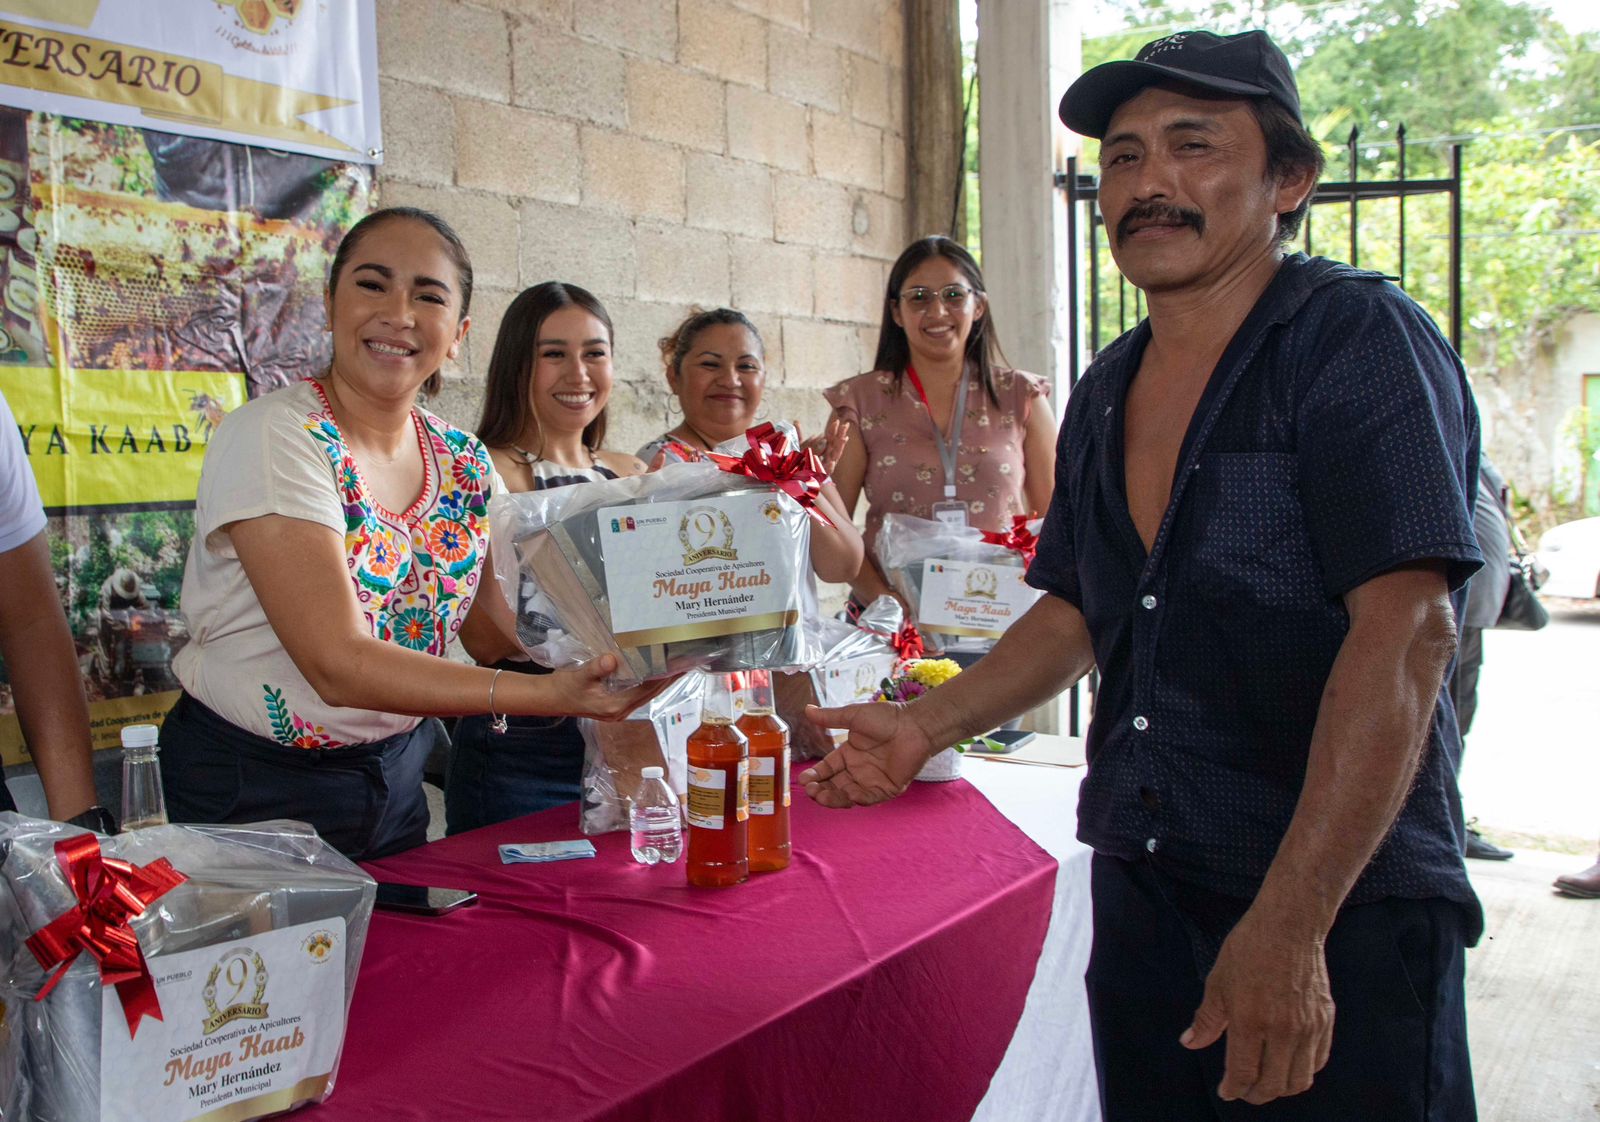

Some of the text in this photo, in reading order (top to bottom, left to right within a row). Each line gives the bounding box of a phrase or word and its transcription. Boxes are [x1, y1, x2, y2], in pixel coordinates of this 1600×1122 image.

[0, 28, 201, 97] ERSARIO
[89, 424, 192, 455] KAAB
[694, 513, 716, 547] 9
[655, 570, 685, 578] Sociedad
[686, 566, 722, 576] Cooperativa
[732, 560, 765, 571] Apicultores
[688, 548, 733, 562] ANIVERSARIO
[653, 568, 772, 600] Maya Kaab
[675, 593, 755, 612] Mary Hernández
[687, 606, 748, 619] Presidenta Municipal
[167, 970, 193, 981] PUEBLO
[225, 957, 248, 1006] 9
[208, 1006, 262, 1029] ANIVERSARIO
[170, 1015, 301, 1058] Sociedad Cooperativa de Apicultores
[163, 1026, 305, 1087] Maya Kaab
[188, 1061, 282, 1099] Mary Hernández
[200, 1079, 272, 1109] Presidenta Municipal
